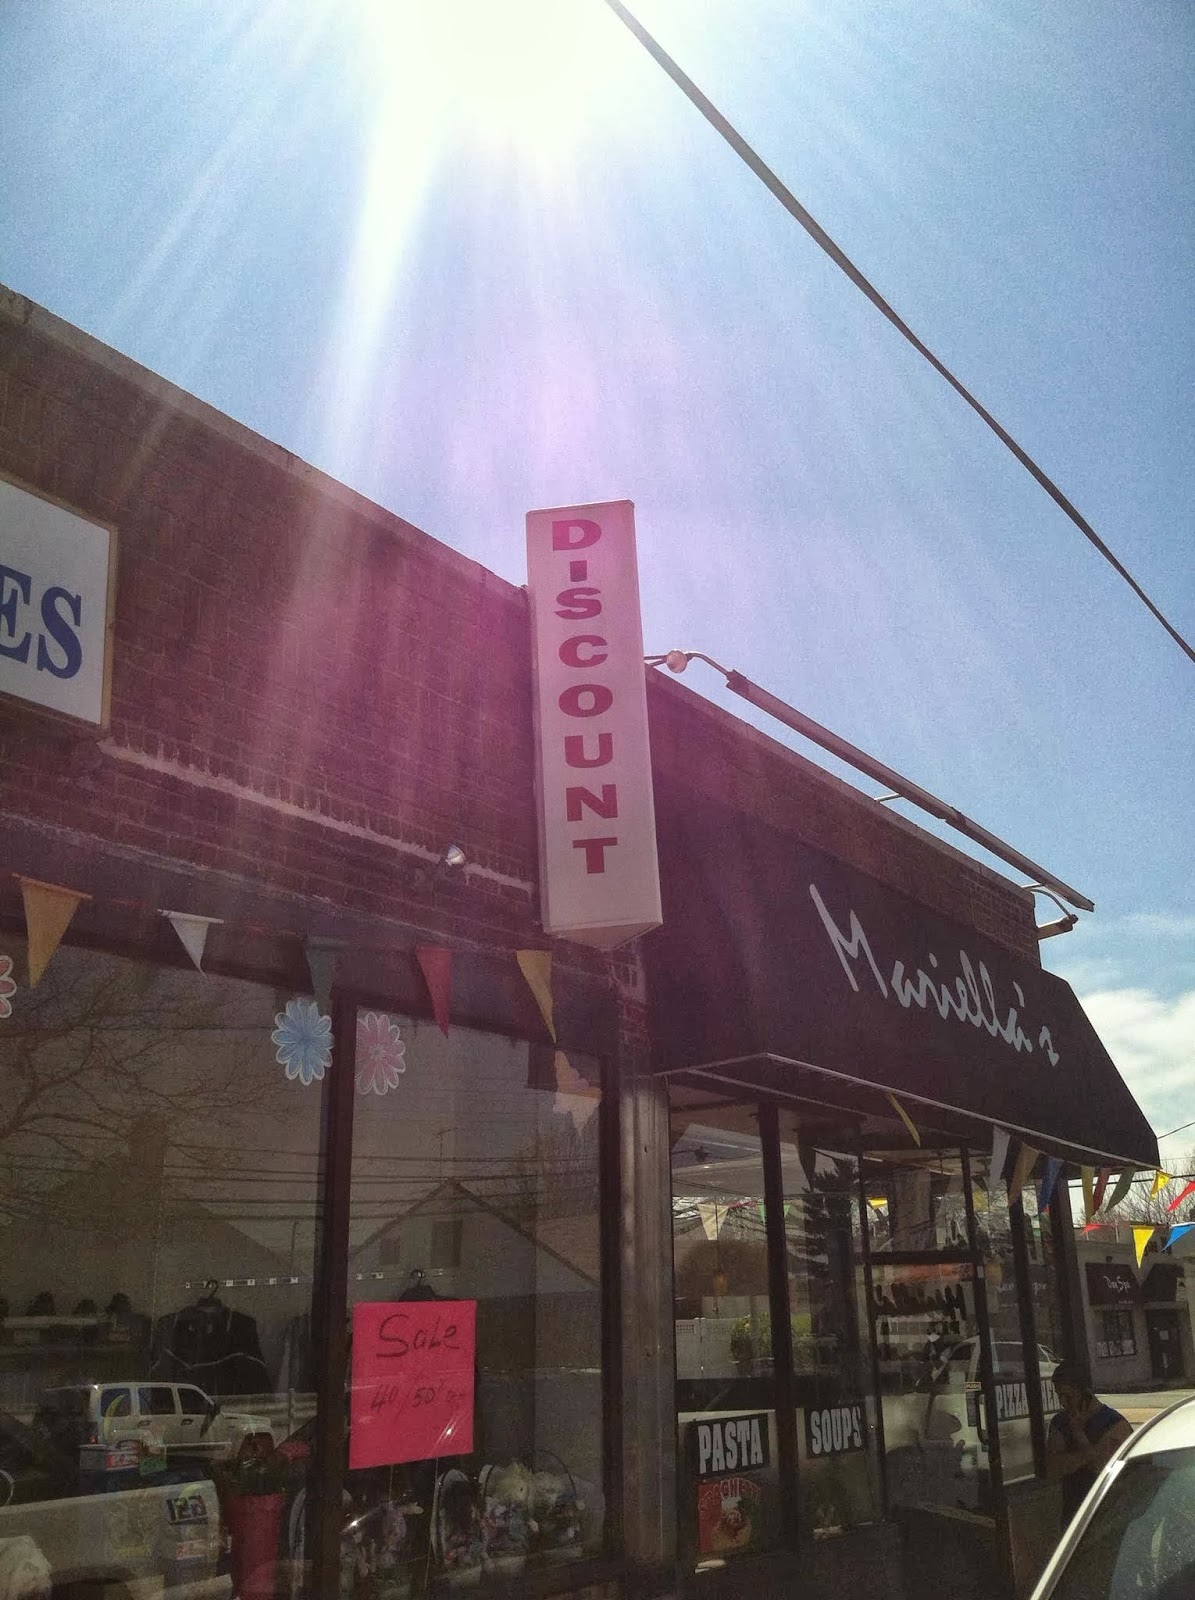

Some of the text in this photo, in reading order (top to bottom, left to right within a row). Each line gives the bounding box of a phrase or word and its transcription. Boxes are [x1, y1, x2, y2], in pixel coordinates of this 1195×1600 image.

[552, 519, 618, 875] DISCOUNT
[809, 883, 1059, 1066] Mariella's
[376, 1314, 460, 1358] Sale
[994, 1382, 1029, 1419] PIZZA
[698, 1419, 763, 1474] PASTA
[811, 1406, 862, 1455] SOUPS
